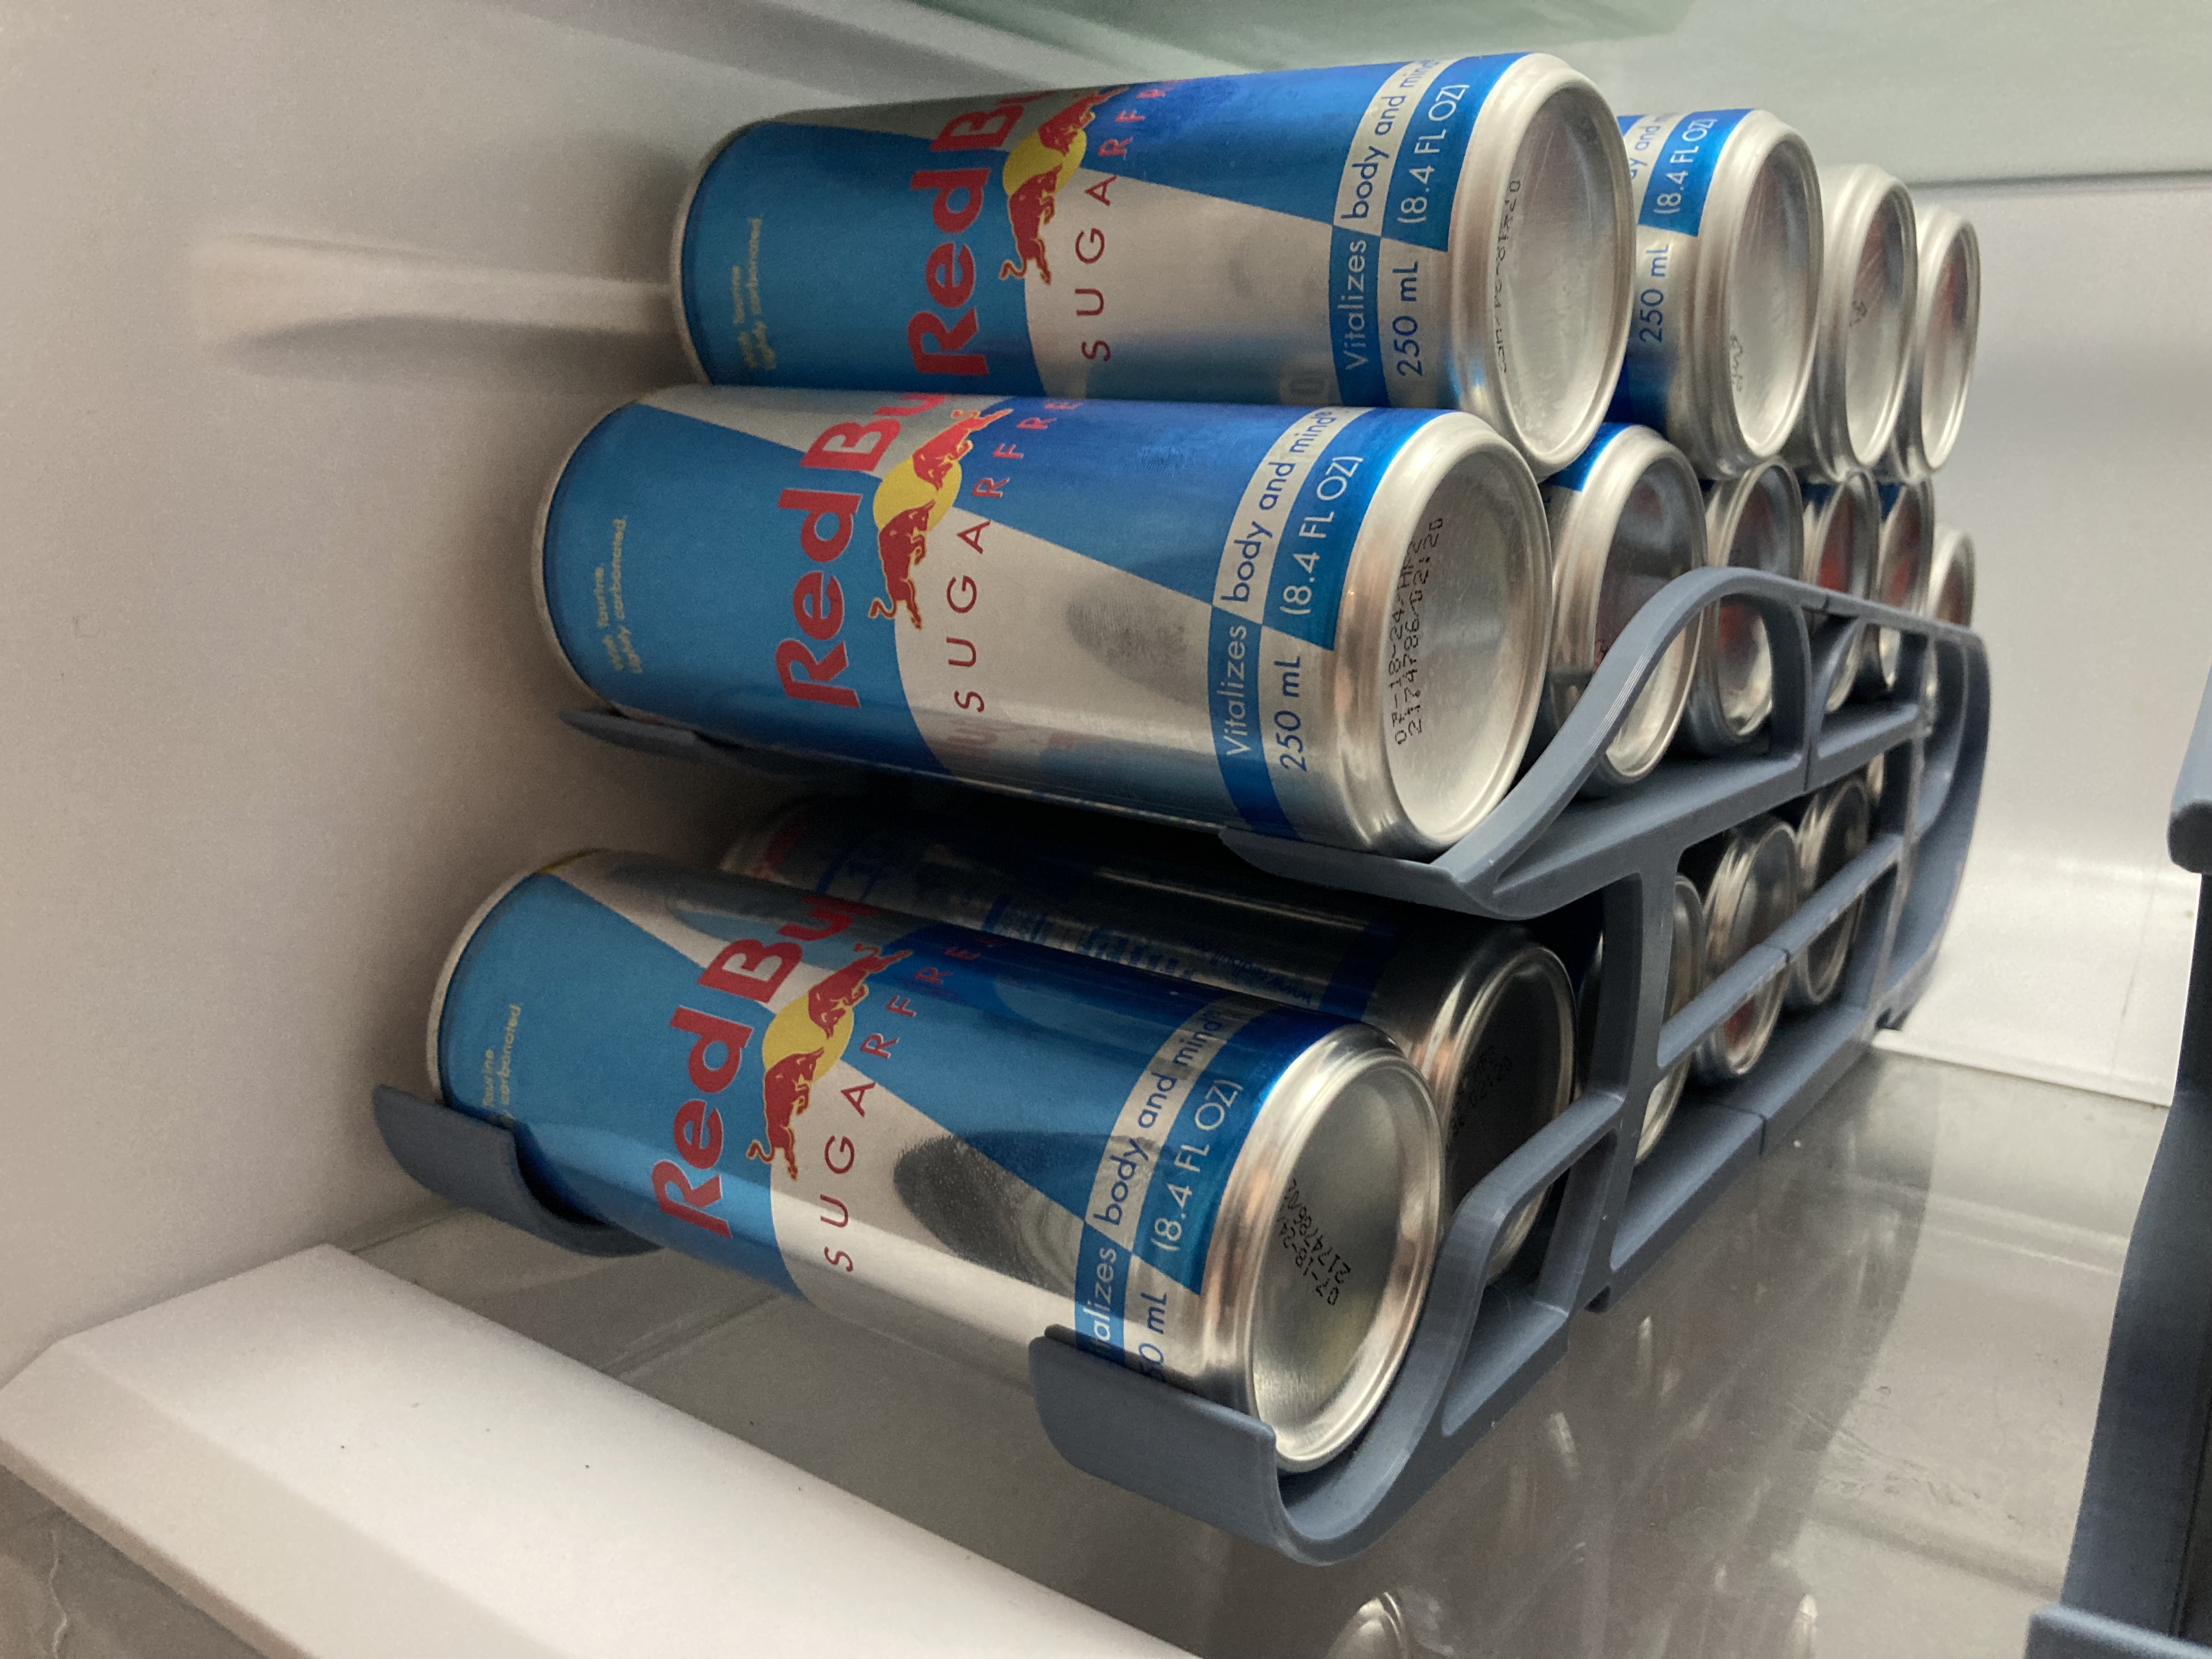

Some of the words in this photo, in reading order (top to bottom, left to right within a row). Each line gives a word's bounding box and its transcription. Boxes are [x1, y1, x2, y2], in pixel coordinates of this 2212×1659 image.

[1373, 95, 1406, 136] and
[1427, 84, 1470, 122] OZ)
[1414, 128, 1447, 155] FL
[1634, 125, 1661, 151] and
[1670, 145, 1700, 165] FL
[1681, 117, 1718, 143] OZ)
[1340, 146, 1390, 220] body
[1400, 165, 1435, 225] (8.4
[1652, 171, 1689, 215] (8.4
[907, 167, 991, 375] Red
[1392, 261, 1419, 302] mL
[1645, 245, 1669, 278] mL
[1336, 239, 1367, 371] Vitalizes
[1639, 289, 1664, 343] 250
[1392, 315, 1423, 377] 250
[1258, 461, 1296, 511] and
[1316, 455, 1364, 501] OZ)
[1298, 511, 1335, 540] FL
[1220, 520, 1274, 603] body
[1279, 551, 1321, 616] (8.4
[774, 488, 864, 709] Red
[1216, 623, 1248, 757] Vitalizes
[1274, 656, 1302, 701] mL
[1278, 709, 1307, 772] 250
[651, 1006, 755, 1240] Red
[1093, 1140, 1148, 1227] body
[1137, 1074, 1178, 1128] and
[1150, 1181, 1194, 1252] (8.4
[1174, 1144, 1210, 1172] FL
[1194, 1079, 1244, 1131] OZ)
[1140, 1291, 1167, 1335] mL
